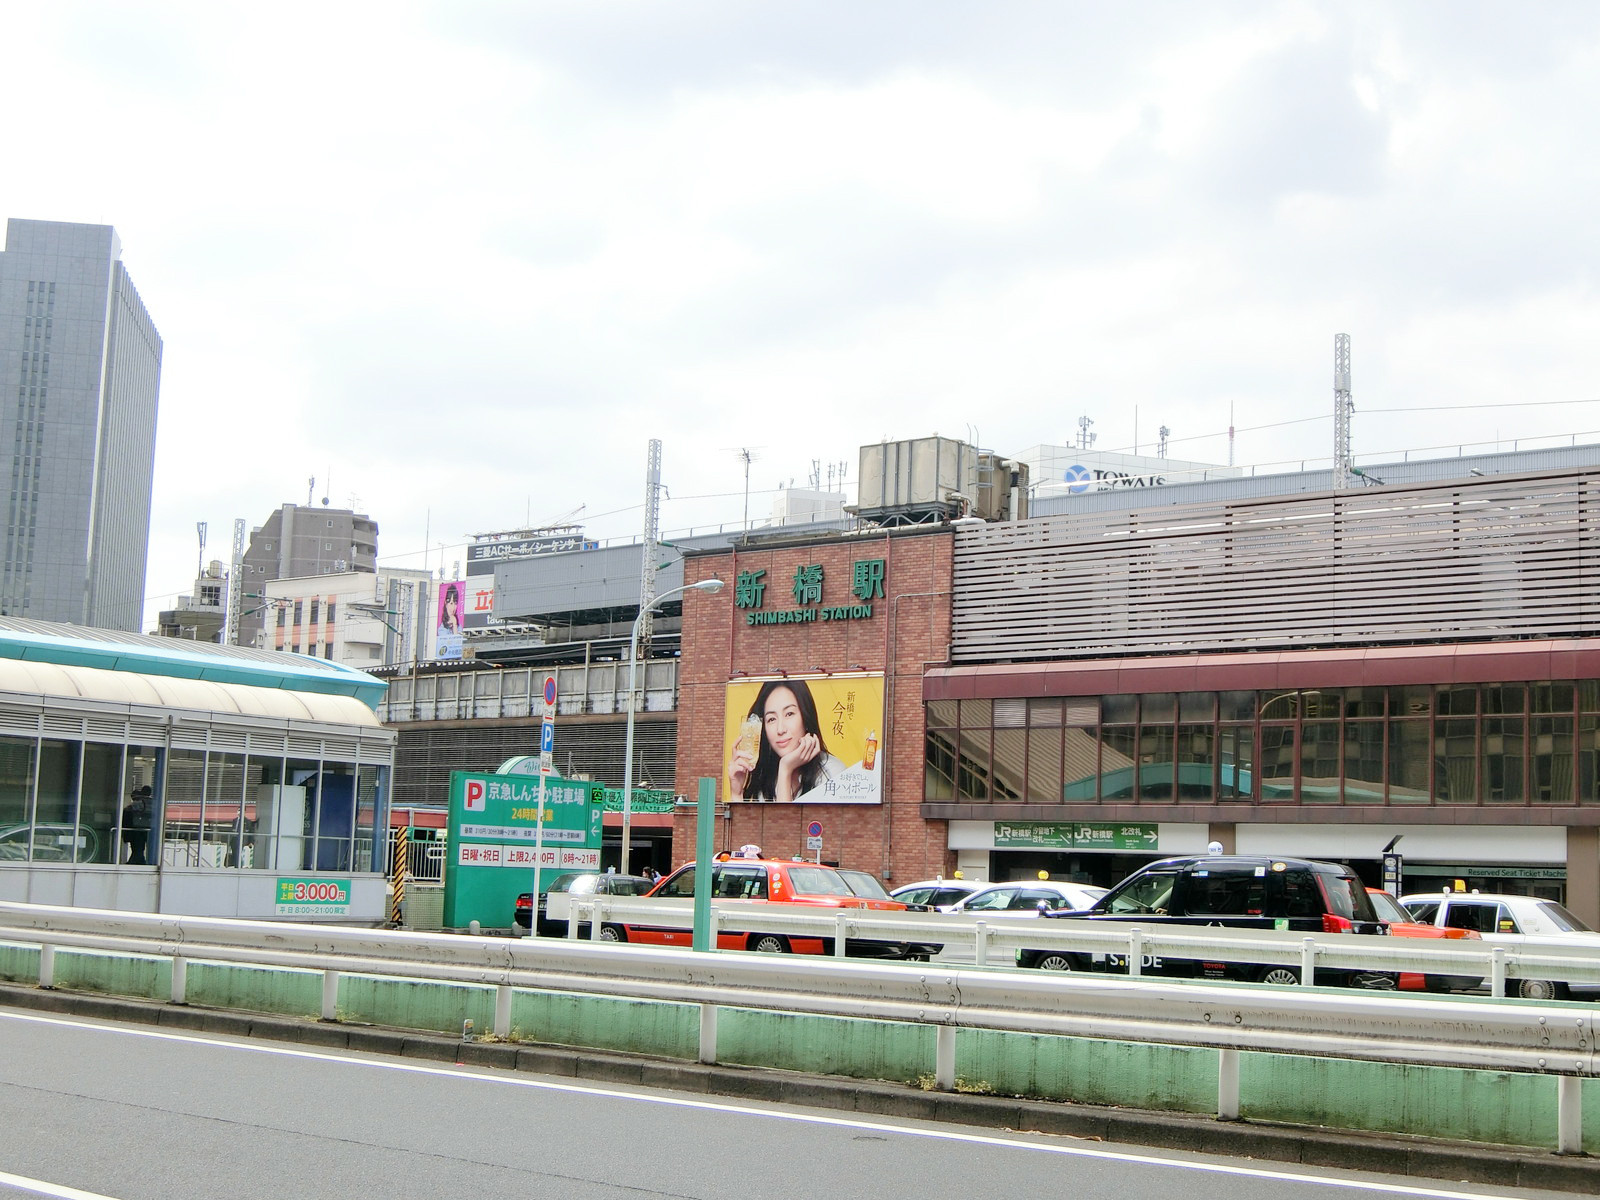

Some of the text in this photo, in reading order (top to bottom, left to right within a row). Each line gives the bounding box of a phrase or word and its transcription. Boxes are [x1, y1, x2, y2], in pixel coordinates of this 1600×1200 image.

[735, 559, 885, 608] 新橋駅
[746, 605, 872, 625] SHIMBASHI STATION
[846, 691, 855, 720] 新橋で
[544, 726, 552, 749] P
[467, 782, 483, 808] P
[488, 782, 585, 806] 京急しんちか駐車場
[824, 779, 877, 796] 角ハイボール
[591, 810, 600, 823] P
[995, 826, 1011, 838] JR
[1011, 829, 1032, 838] 新橋駅
[1074, 827, 1092, 840] JR
[1092, 830, 1114, 839] 新橋駅
[1121, 826, 1142, 836] 北改札
[461, 848, 500, 862] 日曜・祝日
[507, 850, 555, 864] 上限2,40円
[1468, 868, 1500, 876] Reserved
[1501, 869, 1518, 877] Seat
[1519, 869, 1542, 878] Ticket
[295, 883, 346, 902] 3,000円
